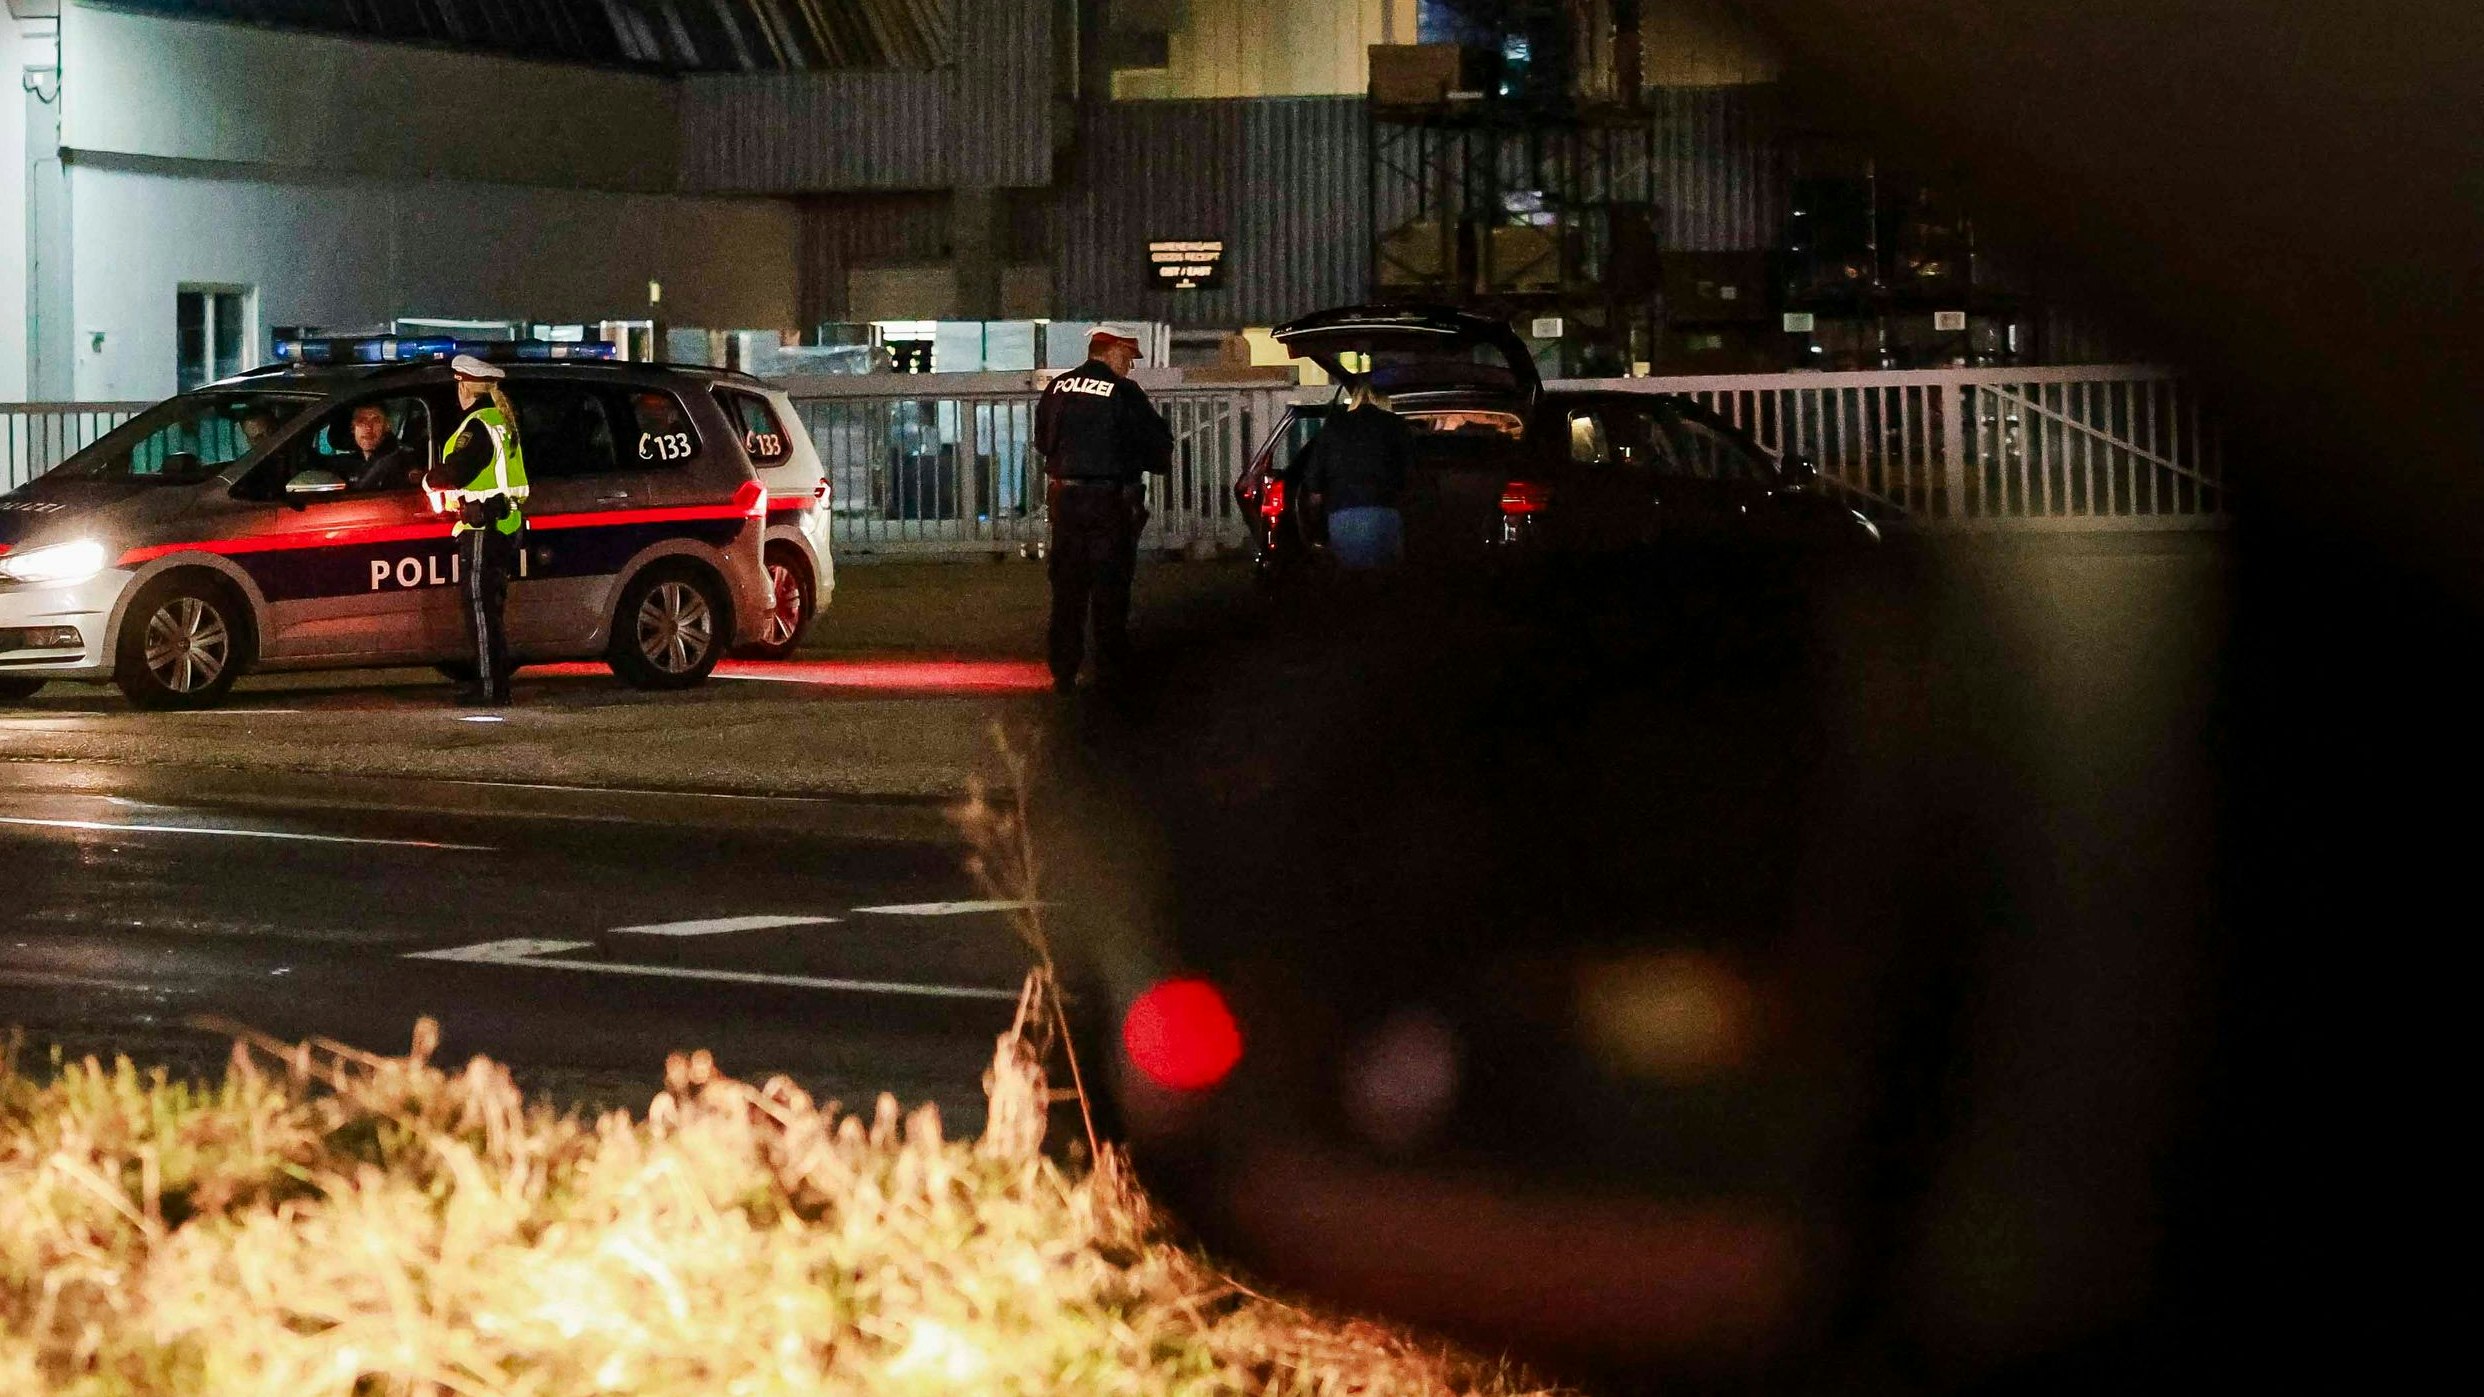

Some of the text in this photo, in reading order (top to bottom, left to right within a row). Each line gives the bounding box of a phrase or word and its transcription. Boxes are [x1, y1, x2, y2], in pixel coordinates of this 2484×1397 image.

[1053, 377, 1115, 397] POLIZEI
[654, 433, 692, 460] 133
[756, 433, 781, 456] 133
[371, 548, 527, 590] POLII
